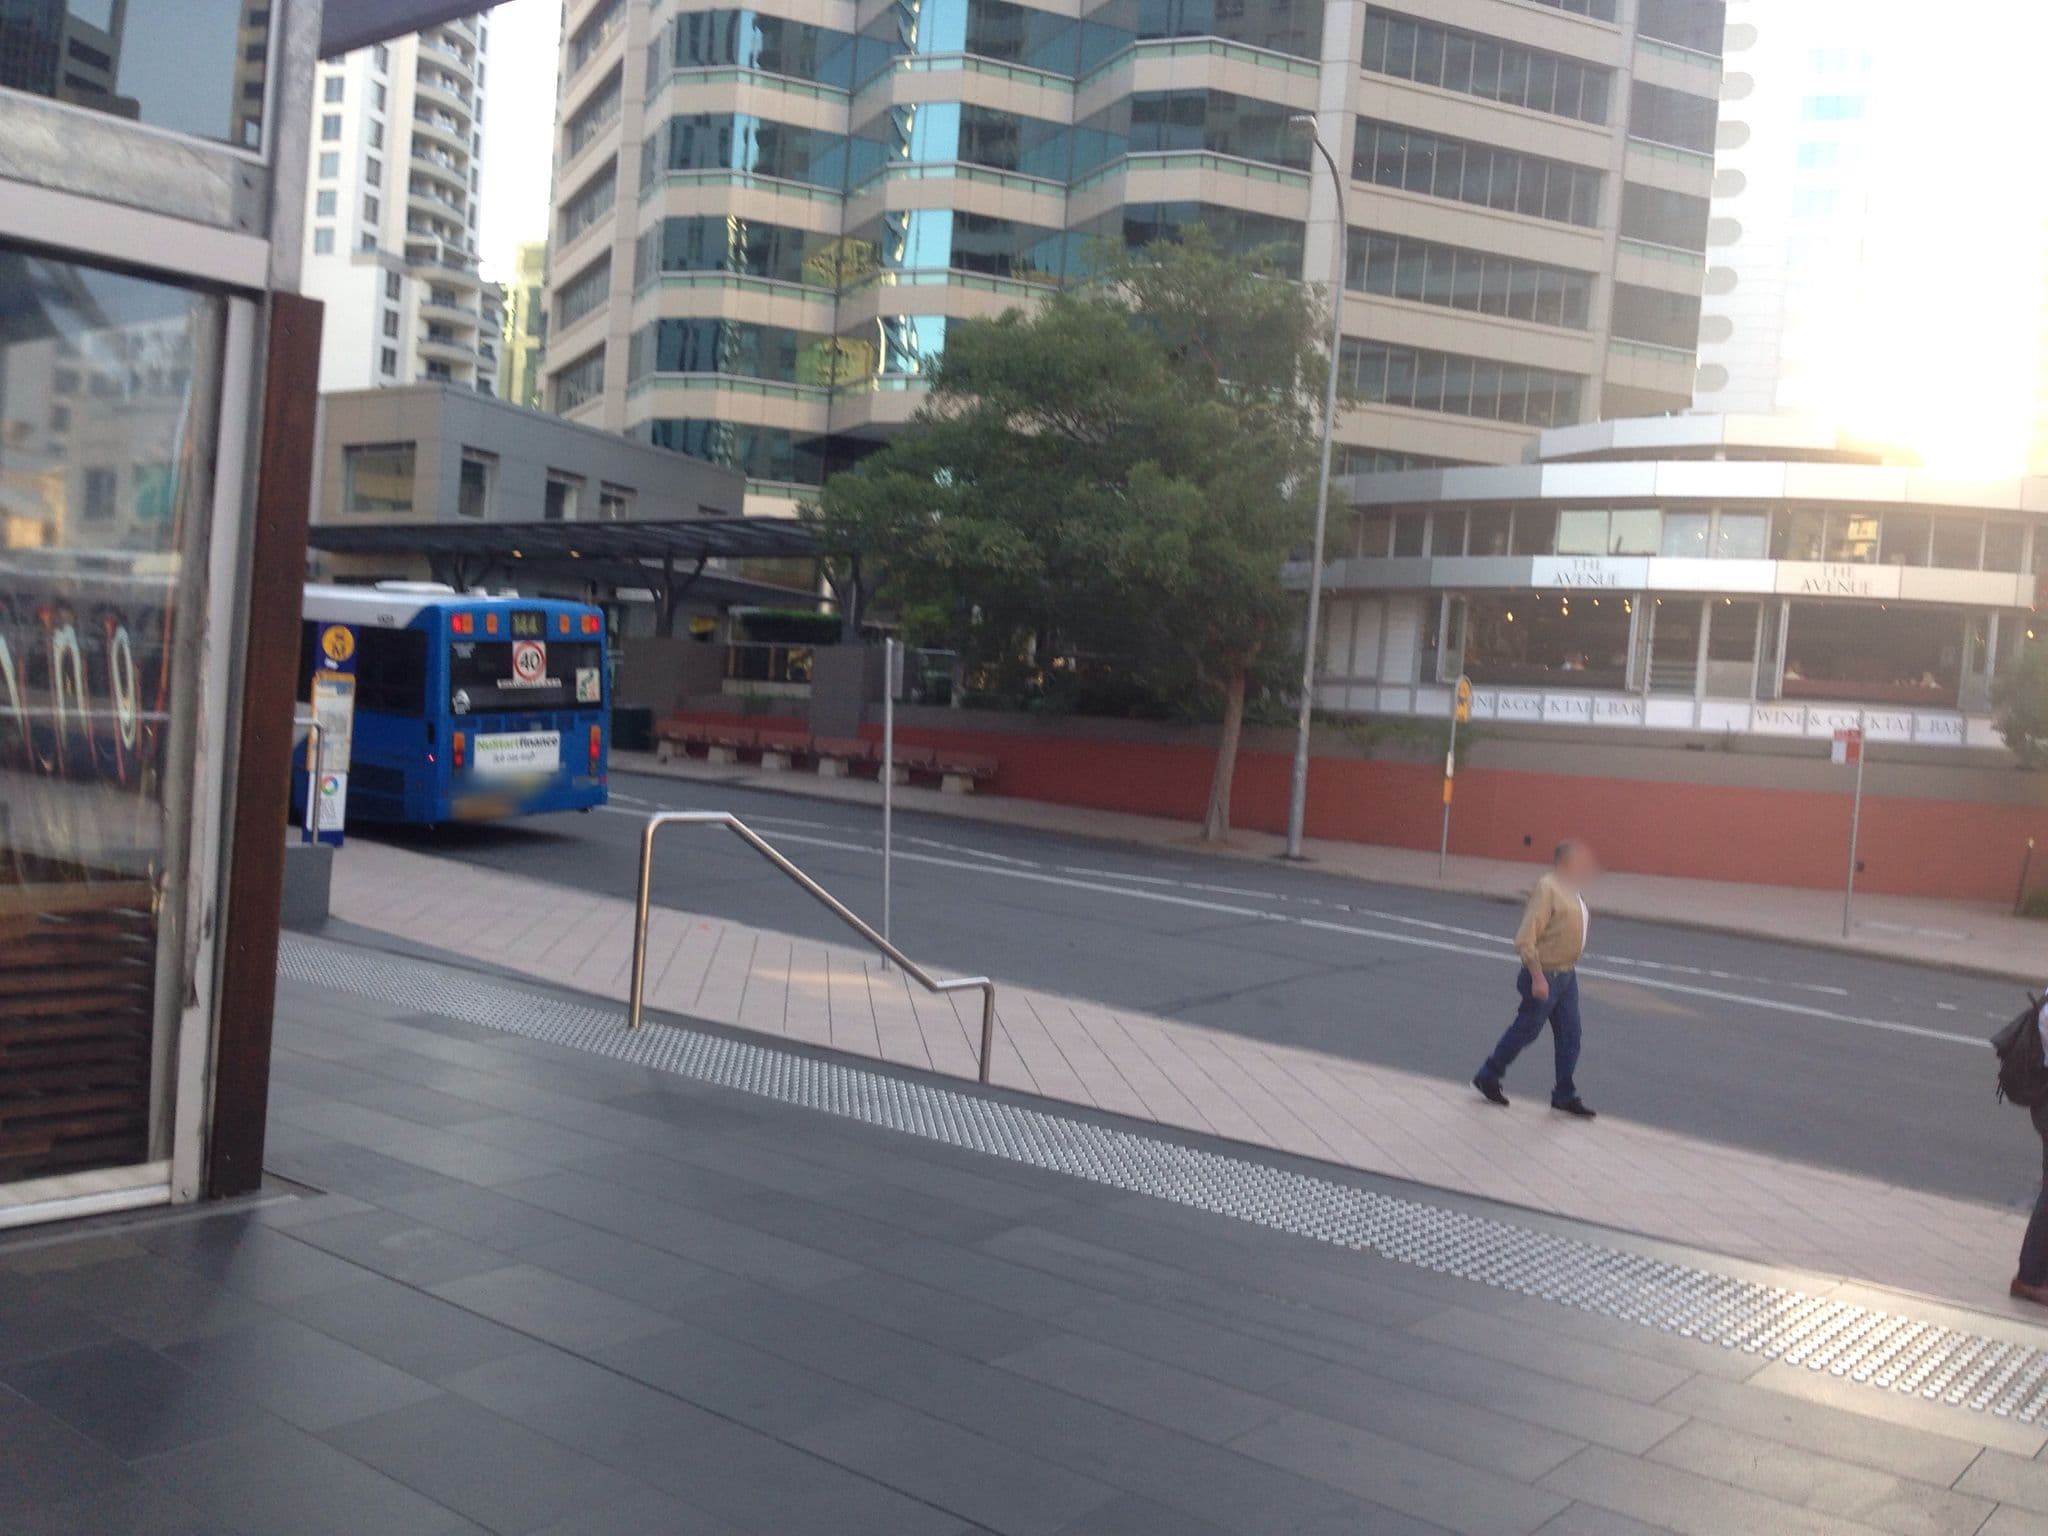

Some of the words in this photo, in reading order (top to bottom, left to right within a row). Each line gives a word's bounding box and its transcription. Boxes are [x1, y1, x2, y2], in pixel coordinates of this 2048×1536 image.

[1573, 559, 1602, 571] THE
[1823, 565, 1852, 578] THE
[1553, 572, 1620, 585] AVENUE
[1801, 578, 1871, 595] AVENUE
[519, 651, 540, 672] 40
[1607, 700, 1642, 716] BAR
[1756, 707, 1803, 726] WINE
[1929, 718, 1969, 736] BAR
